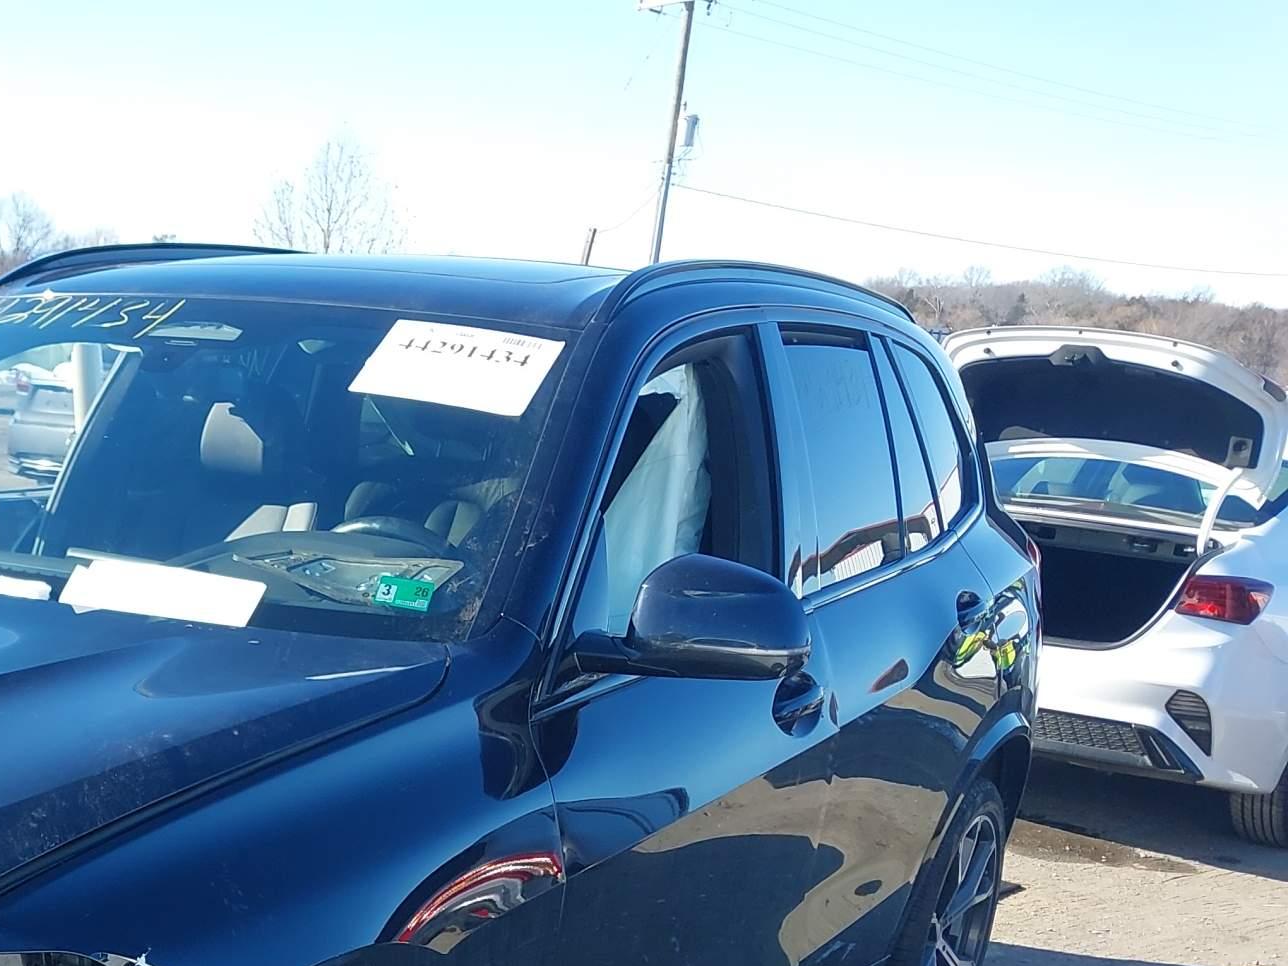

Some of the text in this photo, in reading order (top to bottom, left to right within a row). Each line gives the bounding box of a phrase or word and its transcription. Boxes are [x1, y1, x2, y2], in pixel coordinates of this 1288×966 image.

[398, 337, 531, 367] 44291434
[382, 583, 392, 596] 3
[414, 586, 430, 598] 26
